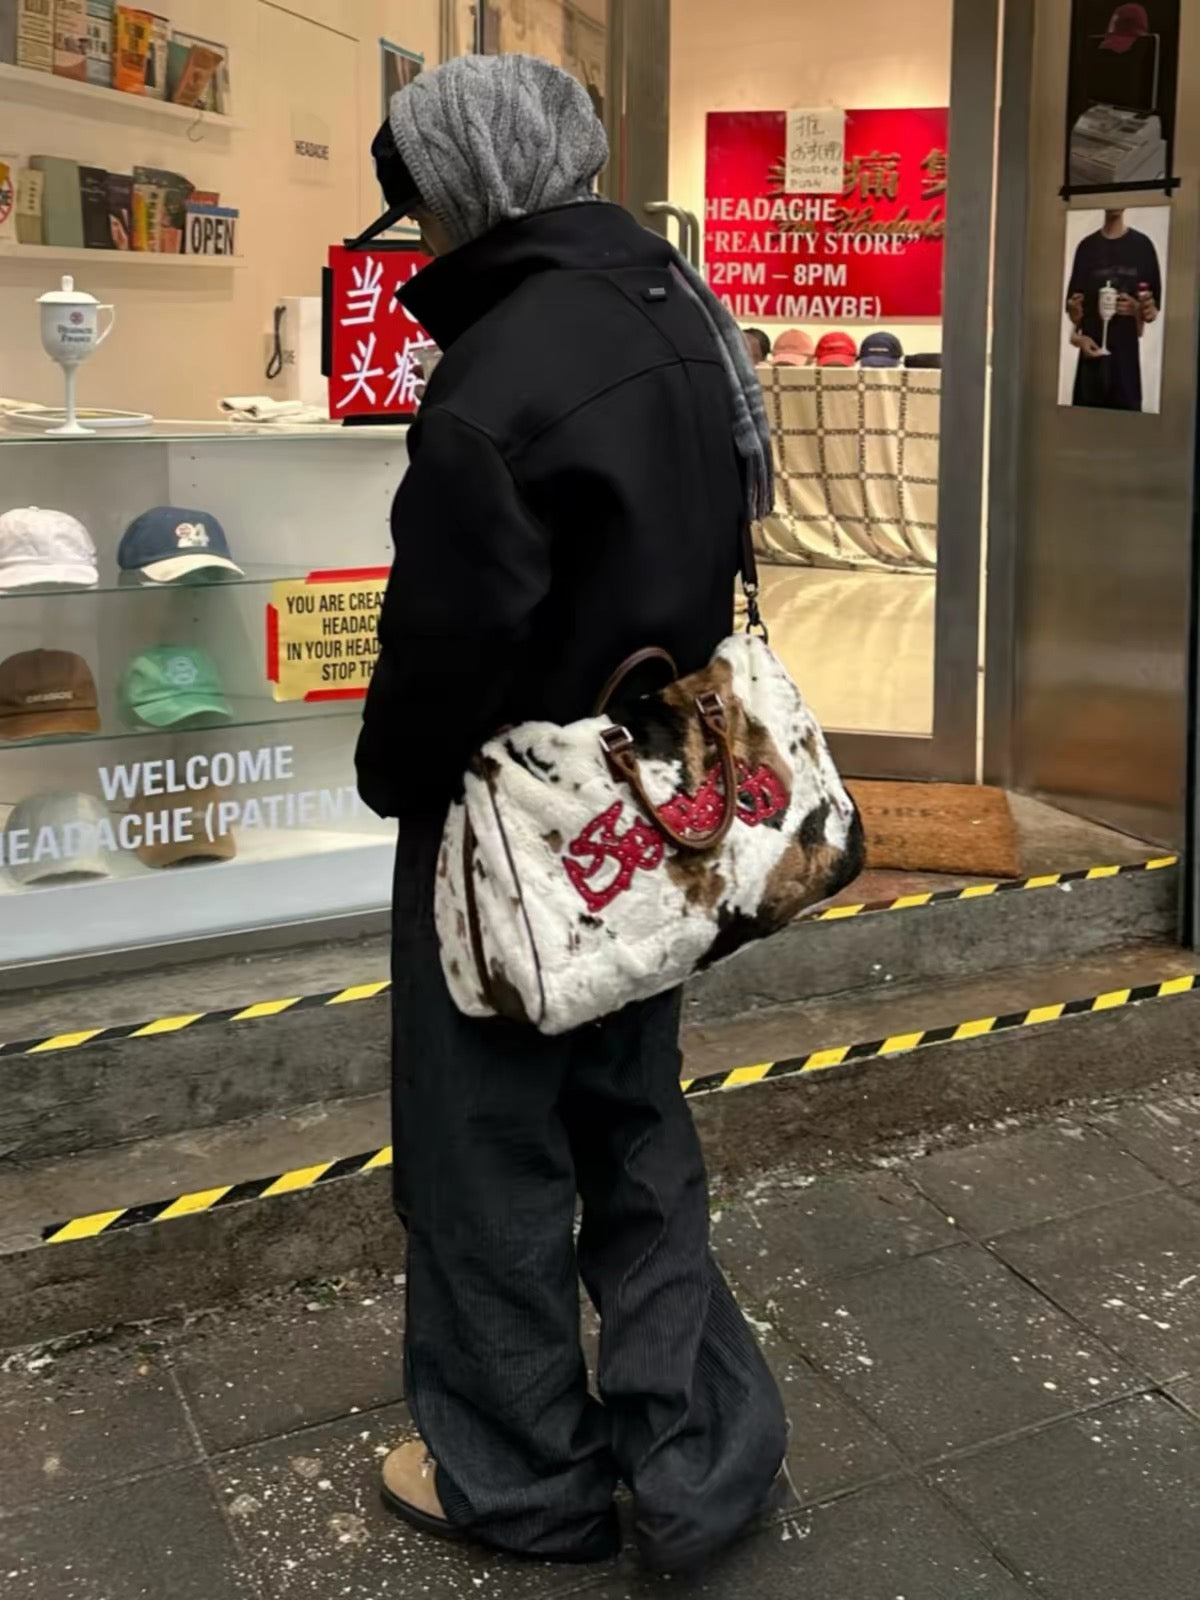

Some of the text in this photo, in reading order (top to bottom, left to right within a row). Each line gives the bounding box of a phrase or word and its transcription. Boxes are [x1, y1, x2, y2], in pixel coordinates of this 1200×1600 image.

[705, 197, 837, 222] HEADACHE
[191, 216, 235, 255] OPEN
[793, 263, 847, 287] 8PM
[719, 293, 881, 321] AILY (MAYBE)
[286, 595, 315, 615] YOU
[319, 593, 346, 613] ARE
[287, 642, 302, 661] IN
[305, 640, 343, 660] YOUR
[322, 661, 357, 682] STOP
[98, 744, 295, 801] WELCOME
